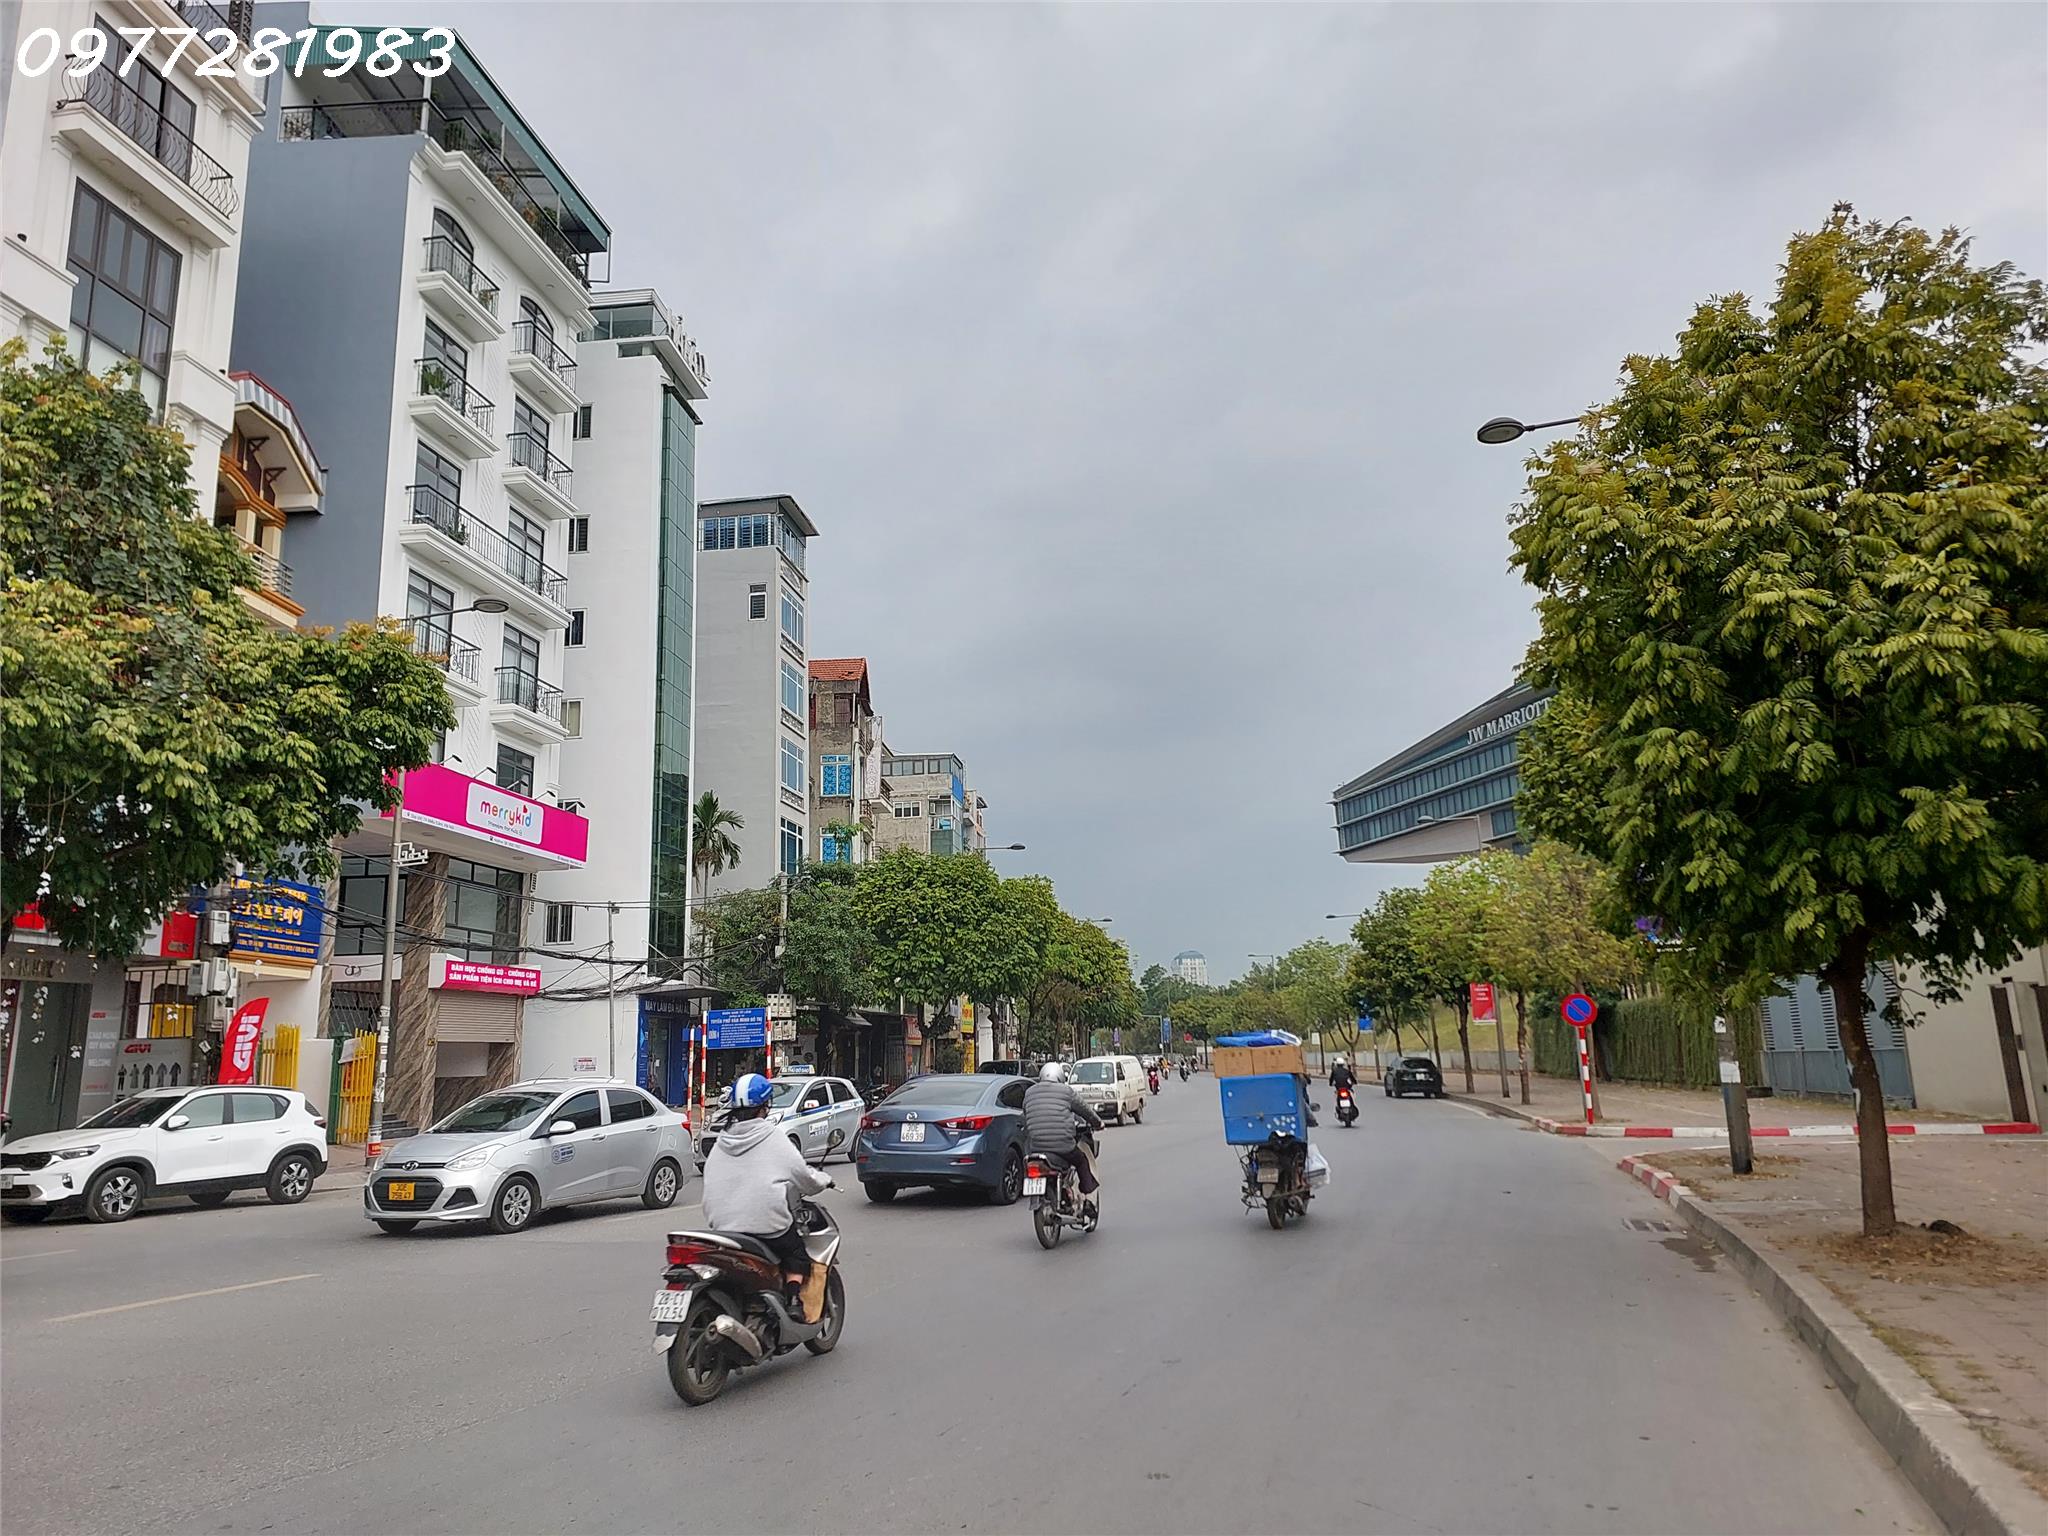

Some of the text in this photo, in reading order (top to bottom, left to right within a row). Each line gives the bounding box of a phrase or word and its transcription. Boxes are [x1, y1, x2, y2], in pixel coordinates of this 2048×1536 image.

[1467, 697, 1552, 745] JW MARRIOTT
[480, 801, 532, 827] merrykid
[124, 1043, 152, 1054] GIVI
[232, 1013, 260, 1072] GIVI
